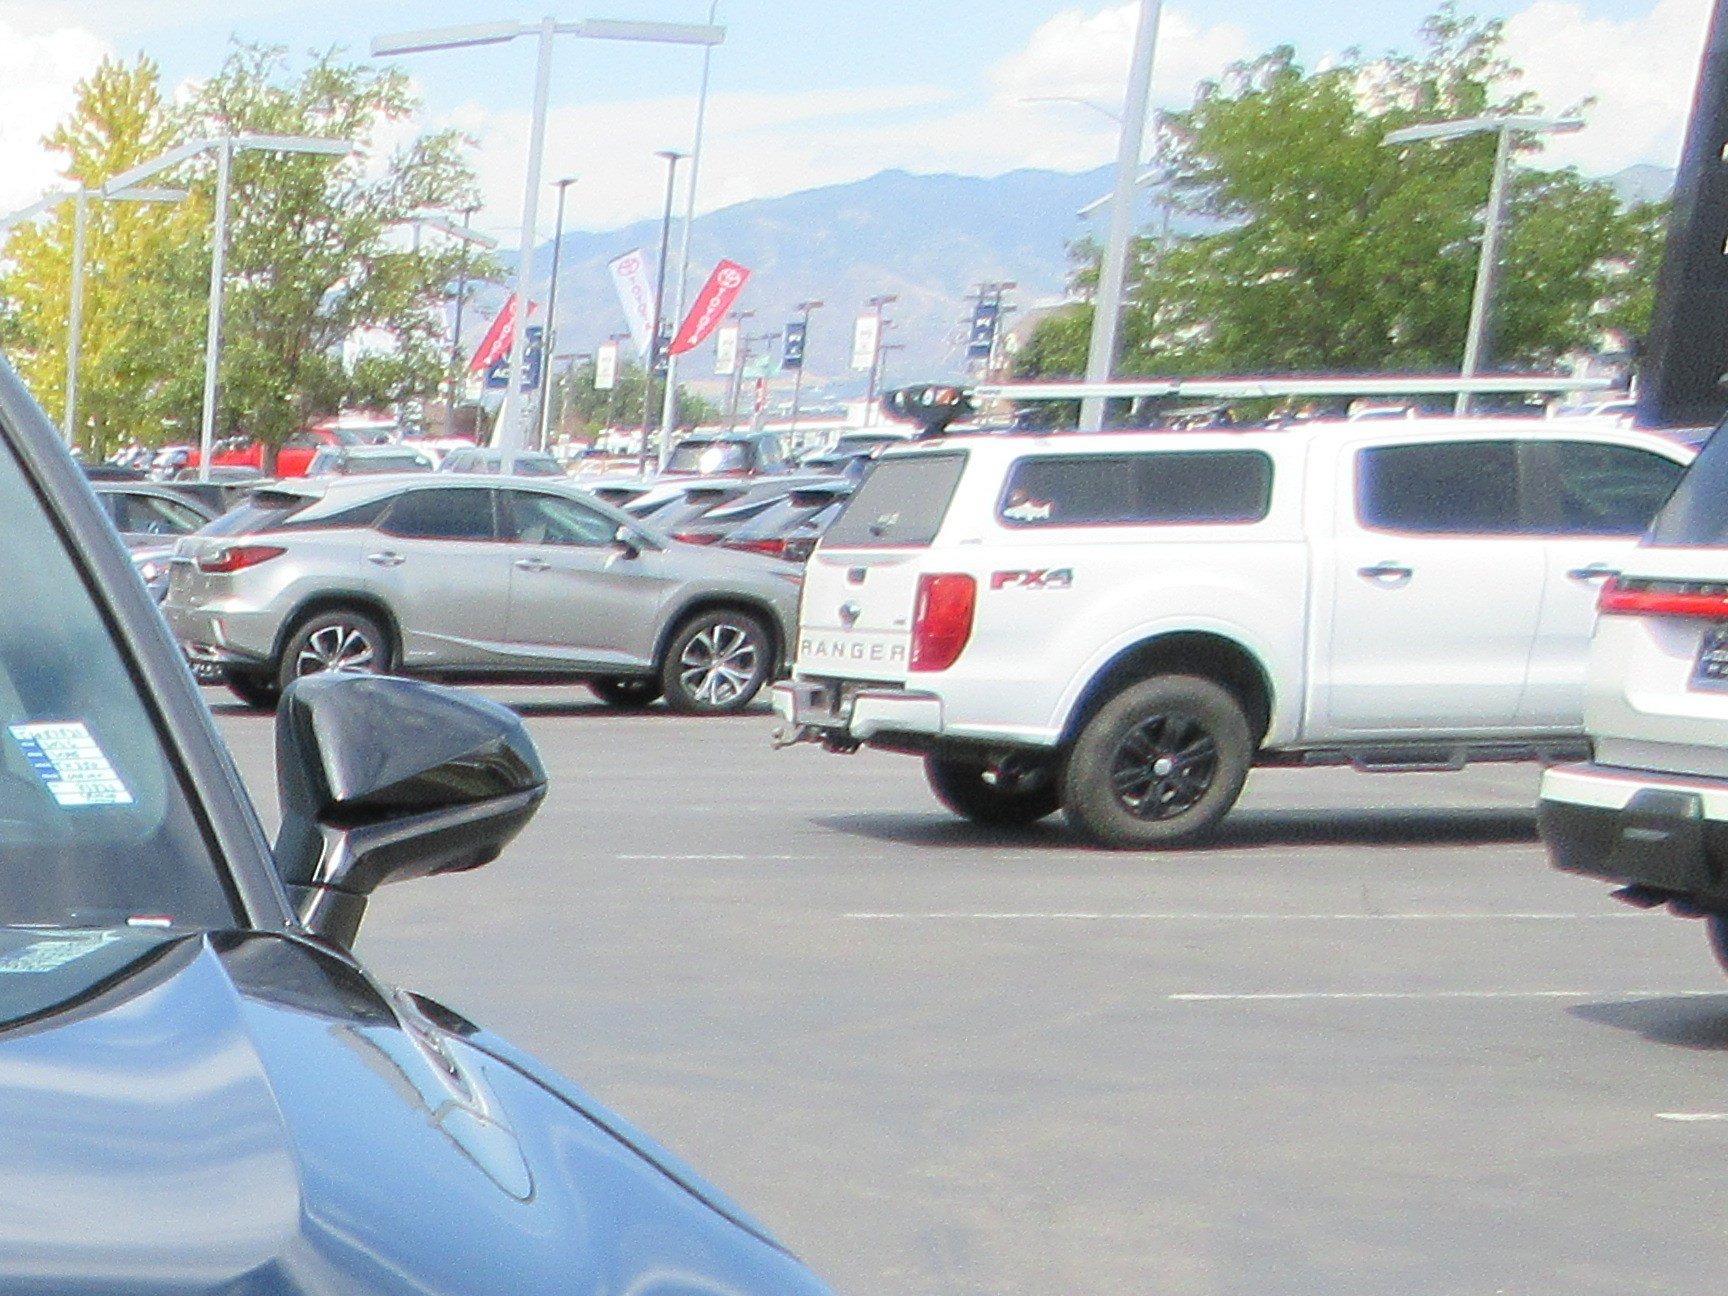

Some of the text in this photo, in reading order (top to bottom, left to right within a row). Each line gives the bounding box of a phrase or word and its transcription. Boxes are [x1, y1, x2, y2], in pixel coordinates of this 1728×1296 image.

[686, 287, 726, 345] TOYOTA
[990, 568, 1074, 590] FX4
[801, 638, 906, 663] RANGER
